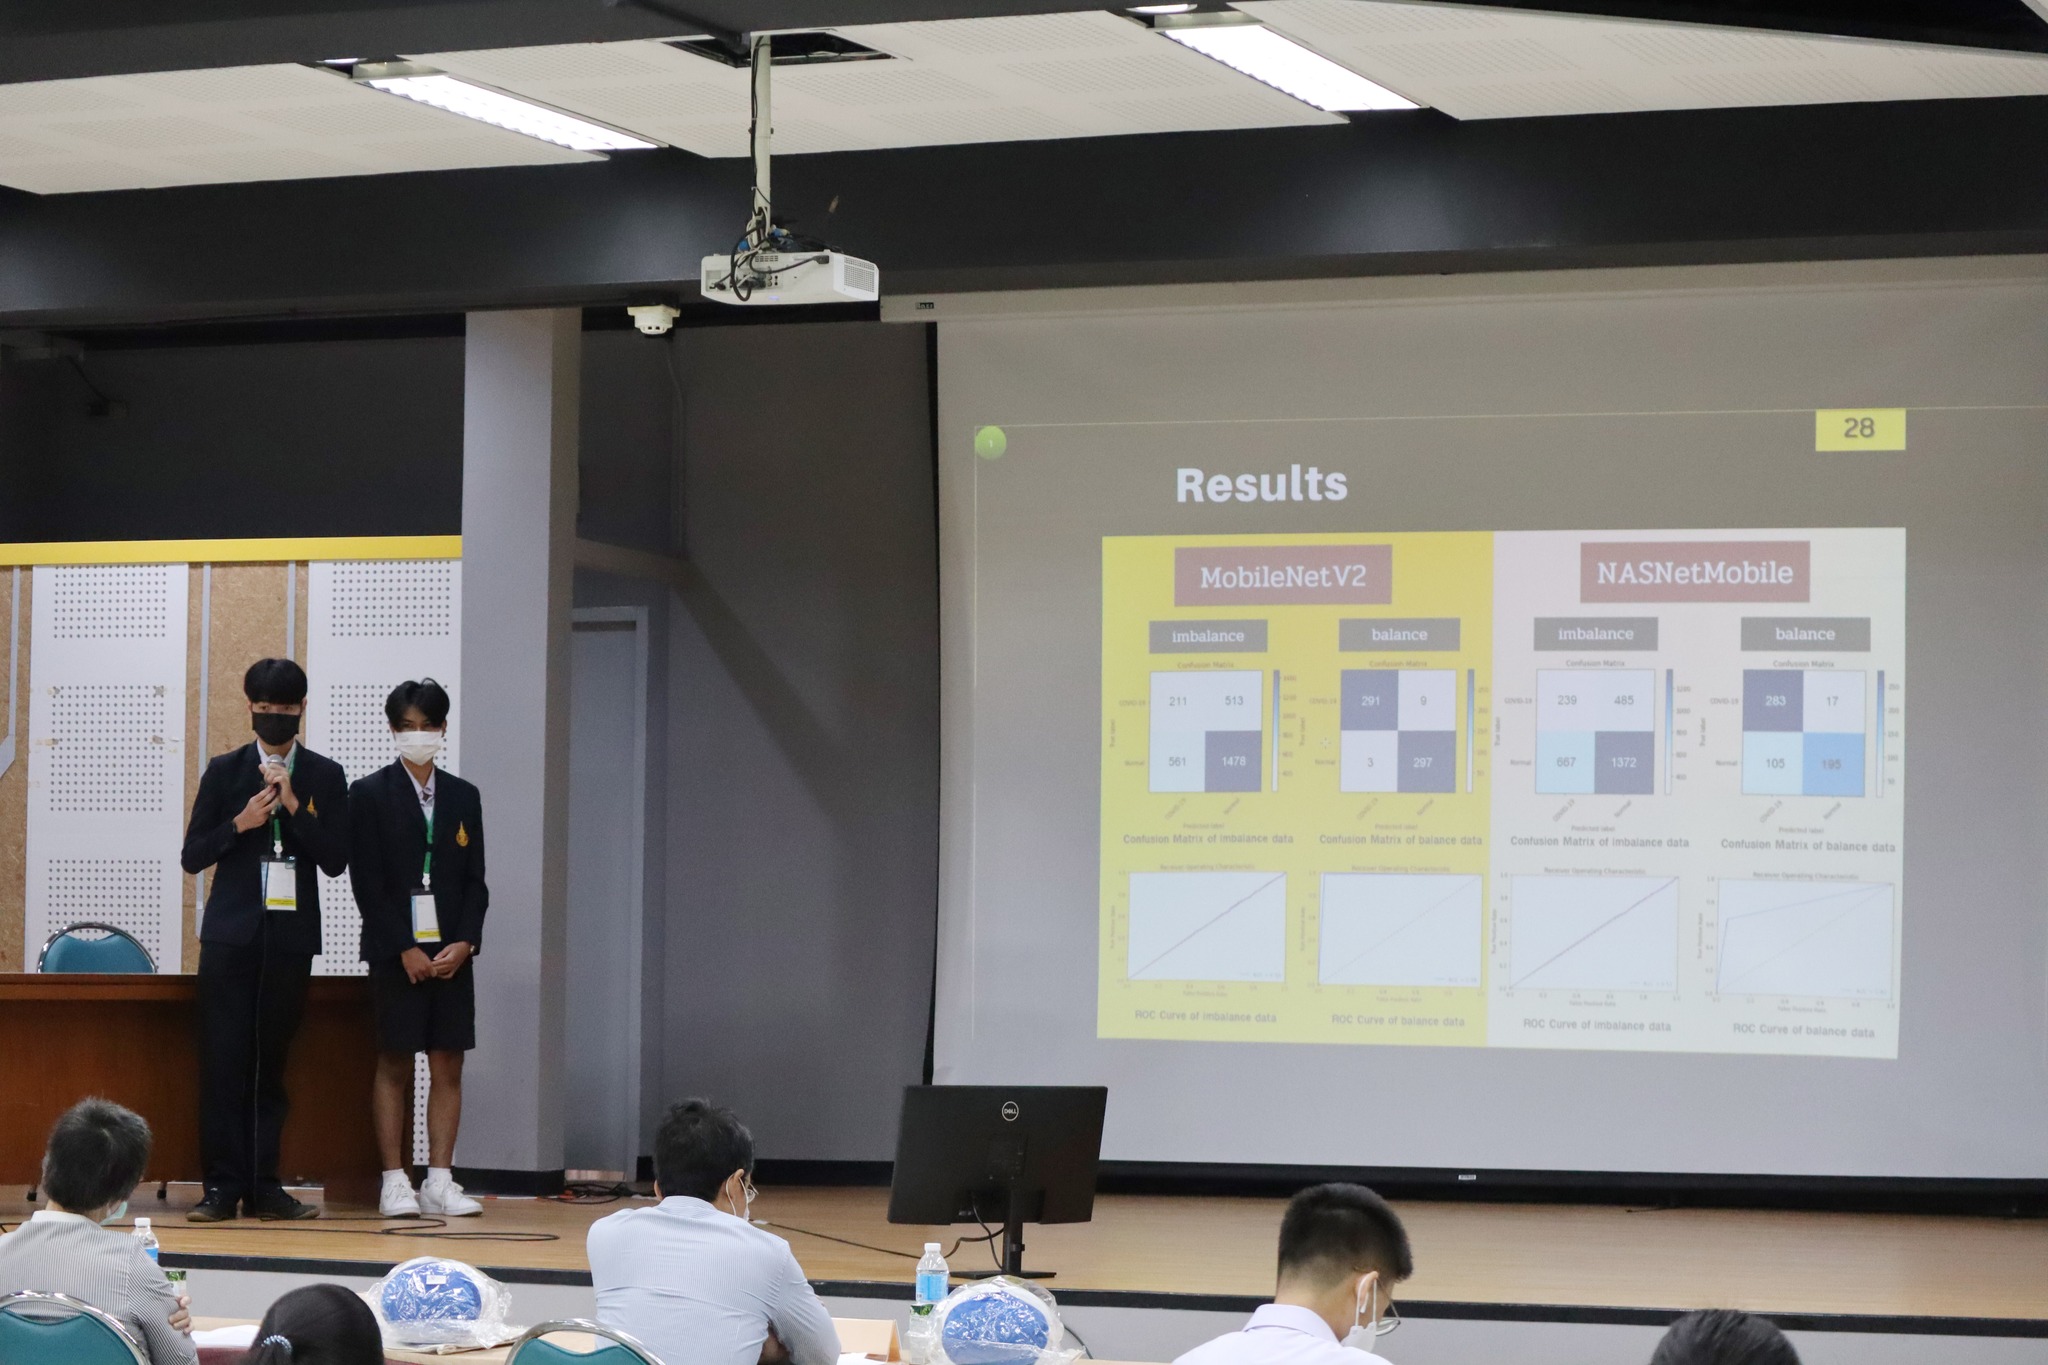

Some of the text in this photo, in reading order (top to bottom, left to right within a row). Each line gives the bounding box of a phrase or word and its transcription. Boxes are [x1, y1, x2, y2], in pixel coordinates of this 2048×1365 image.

[1844, 418, 1875, 439] 28
[1176, 464, 1348, 503] Results
[1597, 561, 1793, 584] NASNetMobile
[1172, 630, 1244, 643] imbalance
[1372, 629, 1428, 641] balance
[1558, 628, 1634, 641] imbalance
[1775, 628, 1835, 641] balance
[1773, 660, 1834, 668] Confusion Matrix
[1169, 697, 1187, 706] 211
[1225, 696, 1244, 706] 513
[1361, 696, 1380, 706] 291
[1420, 696, 1427, 706] 9
[1557, 695, 1577, 705] 239
[1614, 695, 1634, 705] 485
[1765, 696, 1786, 706] 283
[1827, 696, 1839, 706] 17
[1168, 757, 1186, 766] 561
[1222, 756, 1246, 766] 1478
[1367, 757, 1373, 767] 3
[1413, 757, 1432, 768] 297
[1556, 757, 1576, 767] 667
[1611, 757, 1637, 768] 1372
[1766, 758, 1785, 769] 105
[1822, 759, 1842, 770] 195
[1123, 834, 1294, 844] Confusion Matrix of imbalance data
[1320, 835, 1482, 845] Confusion Matrix of balance data
[1511, 836, 1689, 847] Confusion Matrix of imbalance data
[1721, 838, 1896, 852] Confusion Matrix of balance data
[1135, 1010, 1277, 1023] ROC Curve of imbalance data
[1332, 1015, 1465, 1027] ROC Curve of balance data
[1524, 1019, 1672, 1031] ROC Curve of imbalance data
[1733, 1023, 1875, 1038] ROC Curve of balance data
